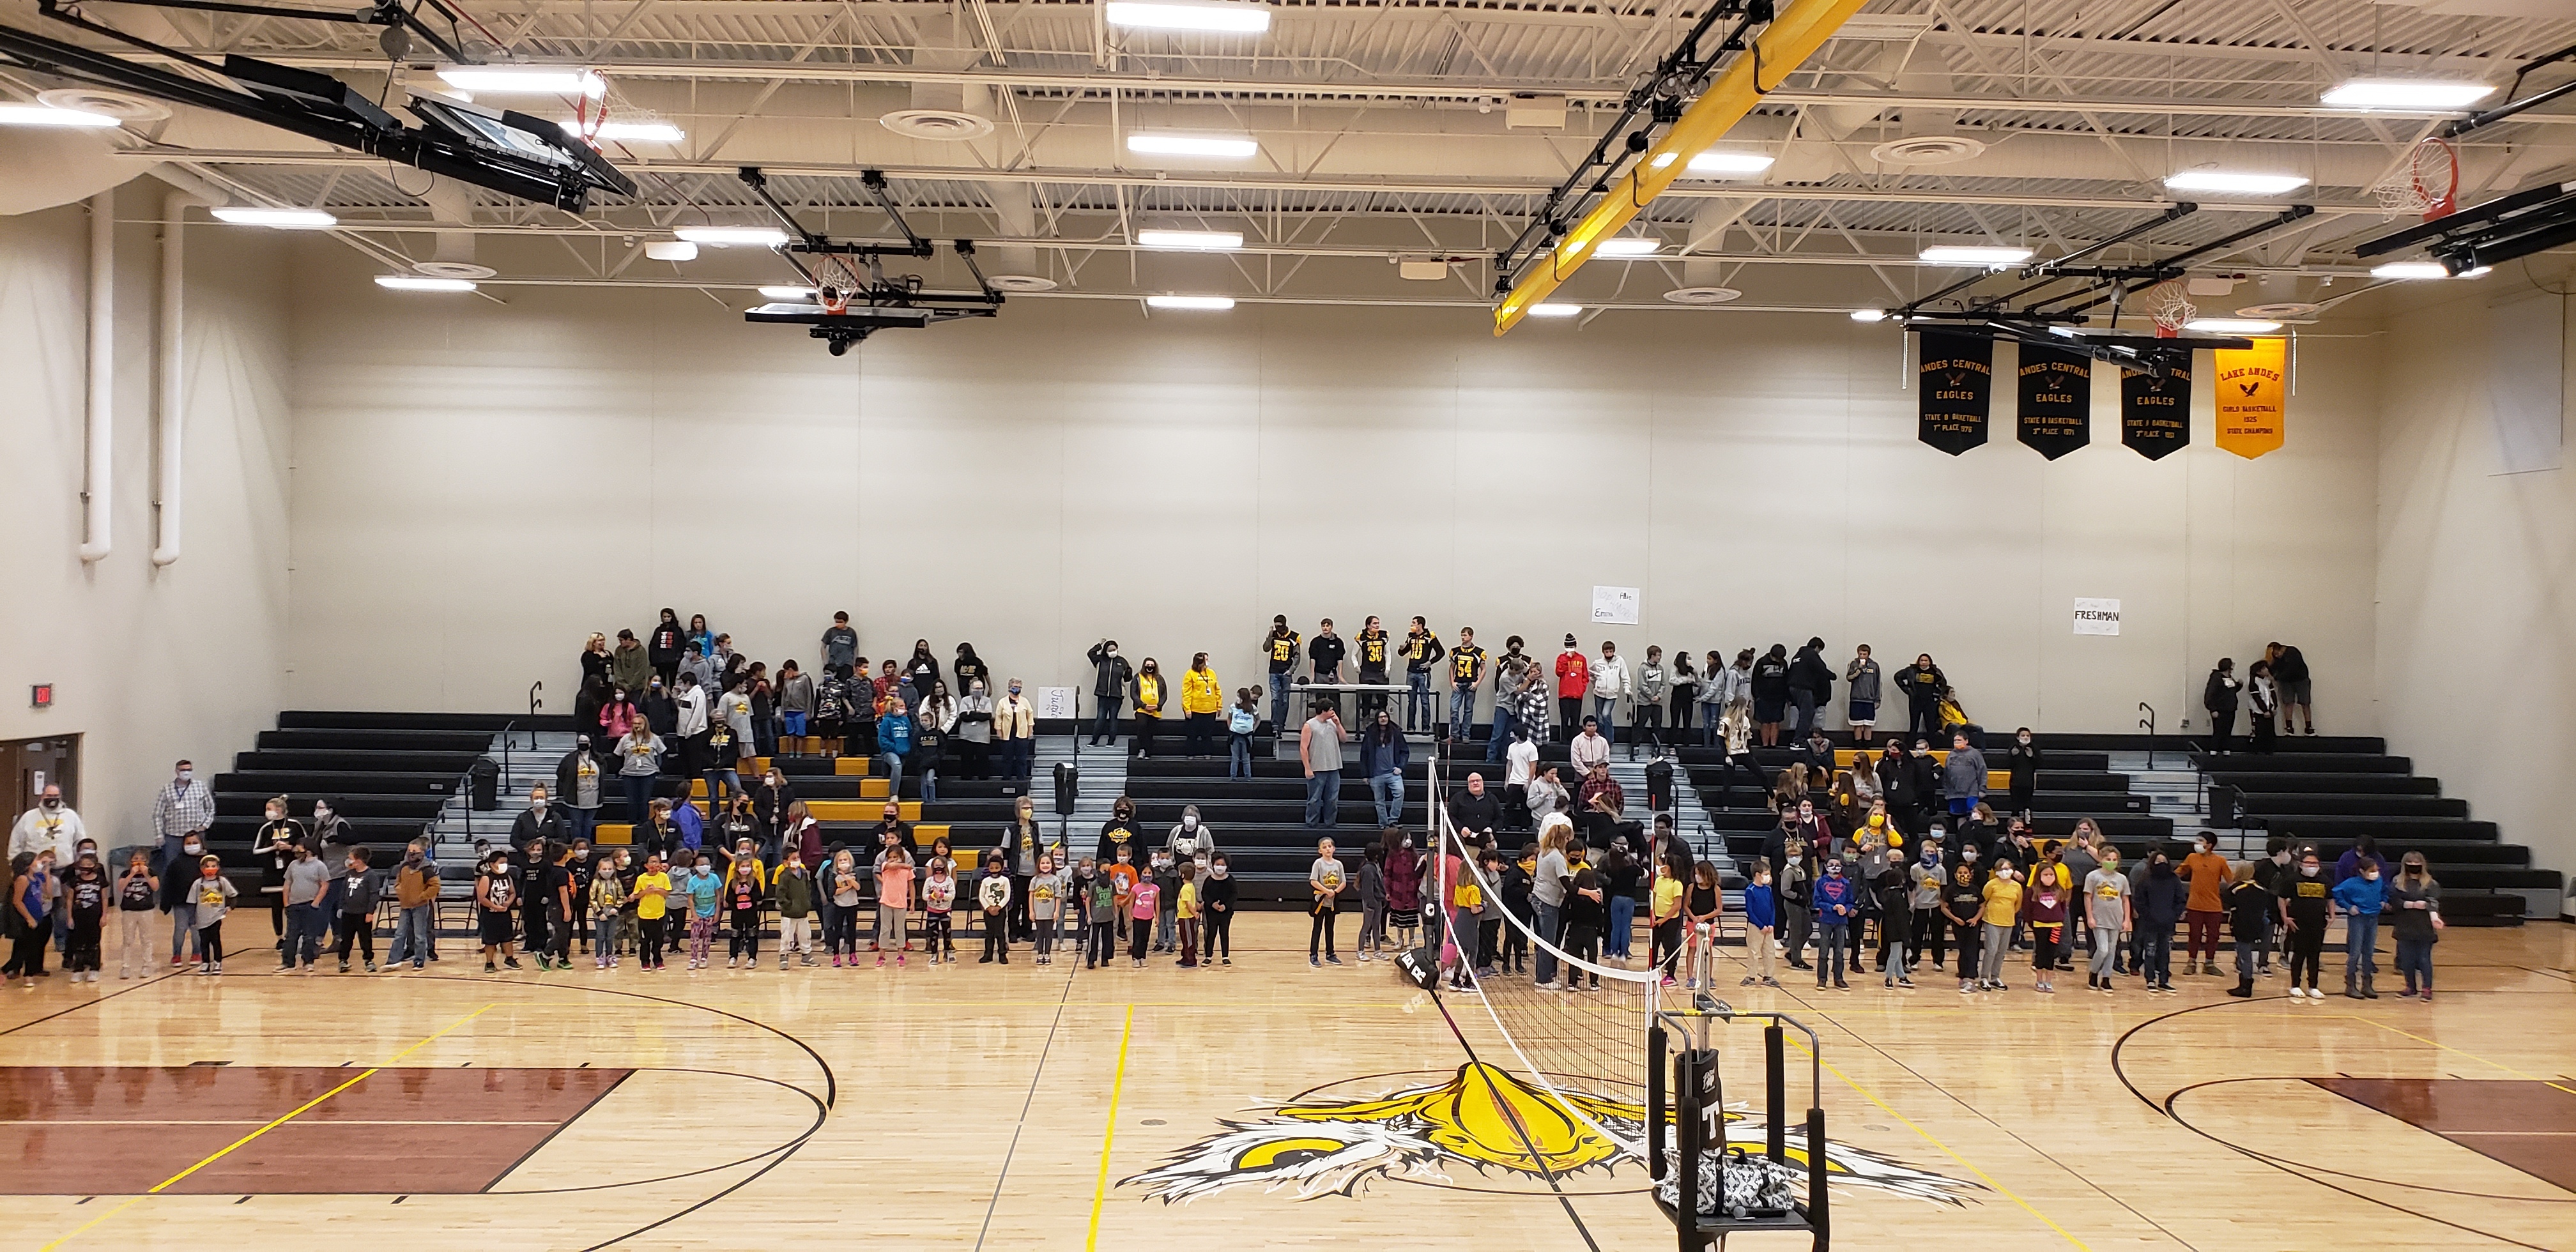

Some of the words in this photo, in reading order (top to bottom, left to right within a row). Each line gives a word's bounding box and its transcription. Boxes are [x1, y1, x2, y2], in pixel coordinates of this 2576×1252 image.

[1920, 360, 1948, 373] ANDES
[1952, 359, 1991, 376] CENTRAL
[2020, 363, 2048, 377] ANDES
[2051, 362, 2089, 378] CENTRAL
[2220, 368, 2246, 381] LAKE
[2248, 367, 2280, 382] ANDES
[1936, 390, 1974, 400] EAGLES
[2035, 393, 2073, 403] EAGLES
[2136, 396, 2175, 406] EAGLES
[1952, 413, 1982, 423] BASKETBALL
[2048, 416, 2083, 425] BASKETBALL
[2074, 610, 2119, 622] FRESHMAN
[1273, 644, 1289, 661] 20
[1367, 645, 1383, 662] 30
[1457, 660, 1472, 678] 54
[271, 827, 290, 840] AC
